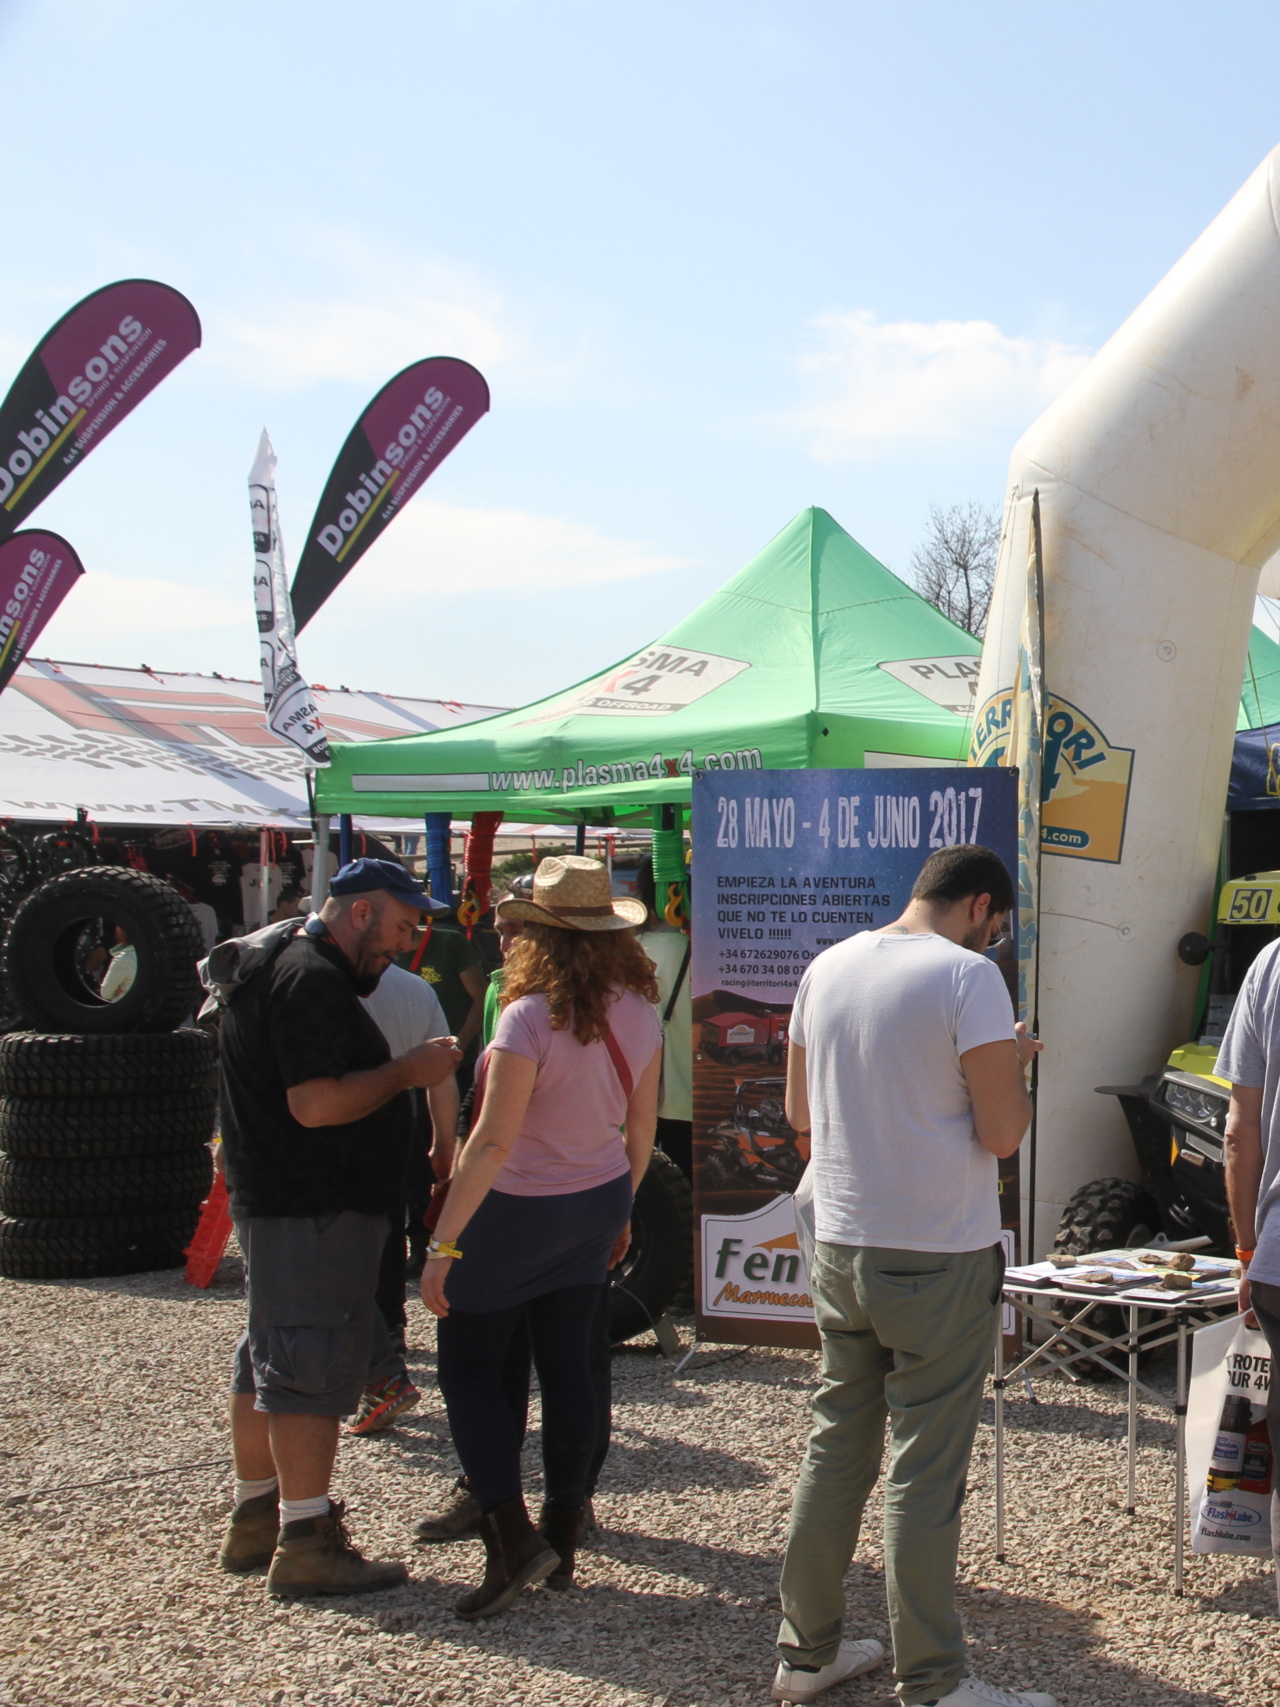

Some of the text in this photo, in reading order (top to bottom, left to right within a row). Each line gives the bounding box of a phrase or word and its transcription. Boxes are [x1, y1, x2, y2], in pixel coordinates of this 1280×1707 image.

[74, 397, 118, 450] SUSPENSION
[114, 390, 125, 402] &
[121, 337, 168, 394] ACCESSORIES
[426, 404, 464, 455] ACCESSORIES
[423, 451, 430, 462] &
[316, 386, 444, 557] Dobinsons
[392, 459, 425, 508] SUSPENSION
[17, 609, 39, 651] SUSPENSION
[40, 558, 62, 603] ACCESSORIES
[597, 698, 672, 712] OFFROAD
[716, 796, 738, 849] 28
[745, 796, 796, 849] MAYO
[818, 798, 831, 849] 4
[838, 795, 861, 849] DE
[867, 795, 921, 849] JUNIO
[928, 786, 983, 848] 2017
[717, 876, 877, 890] EMPIEZA LA AVENTURA
[717, 893, 891, 907] INSCRIPCIONES ABIERTAS
[1231, 890, 1270, 920] 50
[717, 910, 874, 925] QUE NO TE LO CUENTEN
[717, 927, 764, 940] VIVELO
[719, 949, 738, 959] +34
[740, 949, 800, 960] 672629076
[719, 964, 738, 974] +34
[740, 964, 759, 975] 670
[762, 964, 775, 975] 34
[777, 965, 791, 975] 08
[721, 978, 800, 989] racing@territori4x4.
[713, 1281, 815, 1308] Marruecos
[1201, 1527, 1251, 1542] flashlube.com
